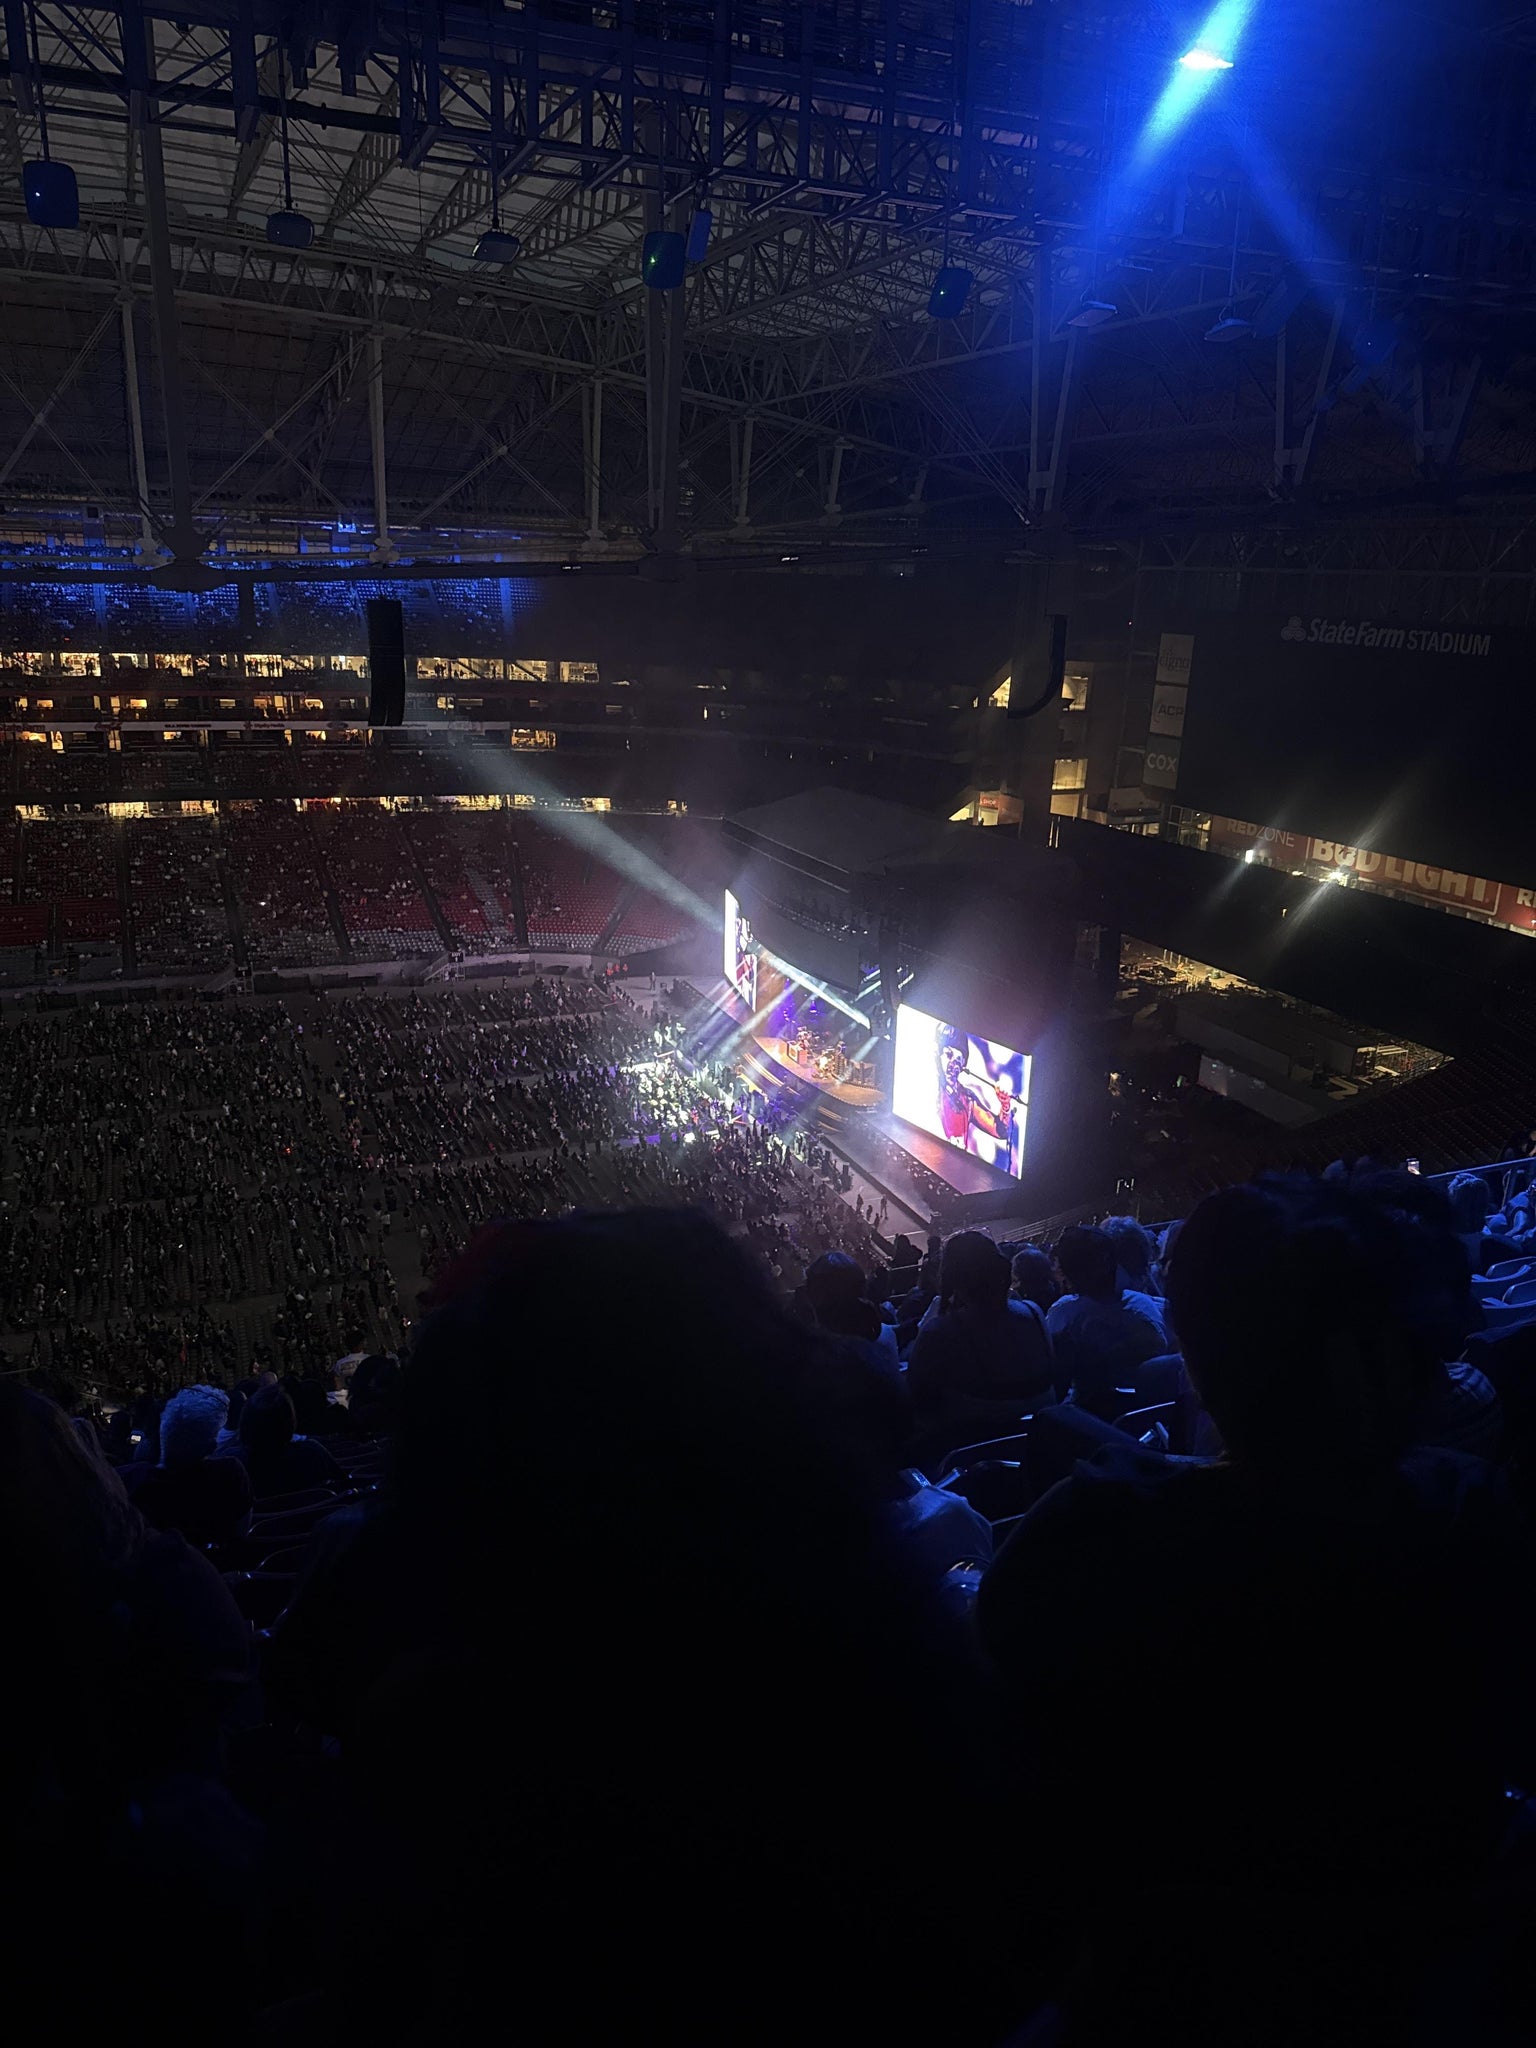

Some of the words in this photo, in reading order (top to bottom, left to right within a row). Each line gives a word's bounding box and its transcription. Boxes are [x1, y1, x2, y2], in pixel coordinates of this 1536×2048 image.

[1406, 629, 1492, 656] STADIUM
[1146, 752, 1177, 772] COX
[1312, 838, 1381, 873] BUD
[1384, 855, 1487, 902] LIGHT
